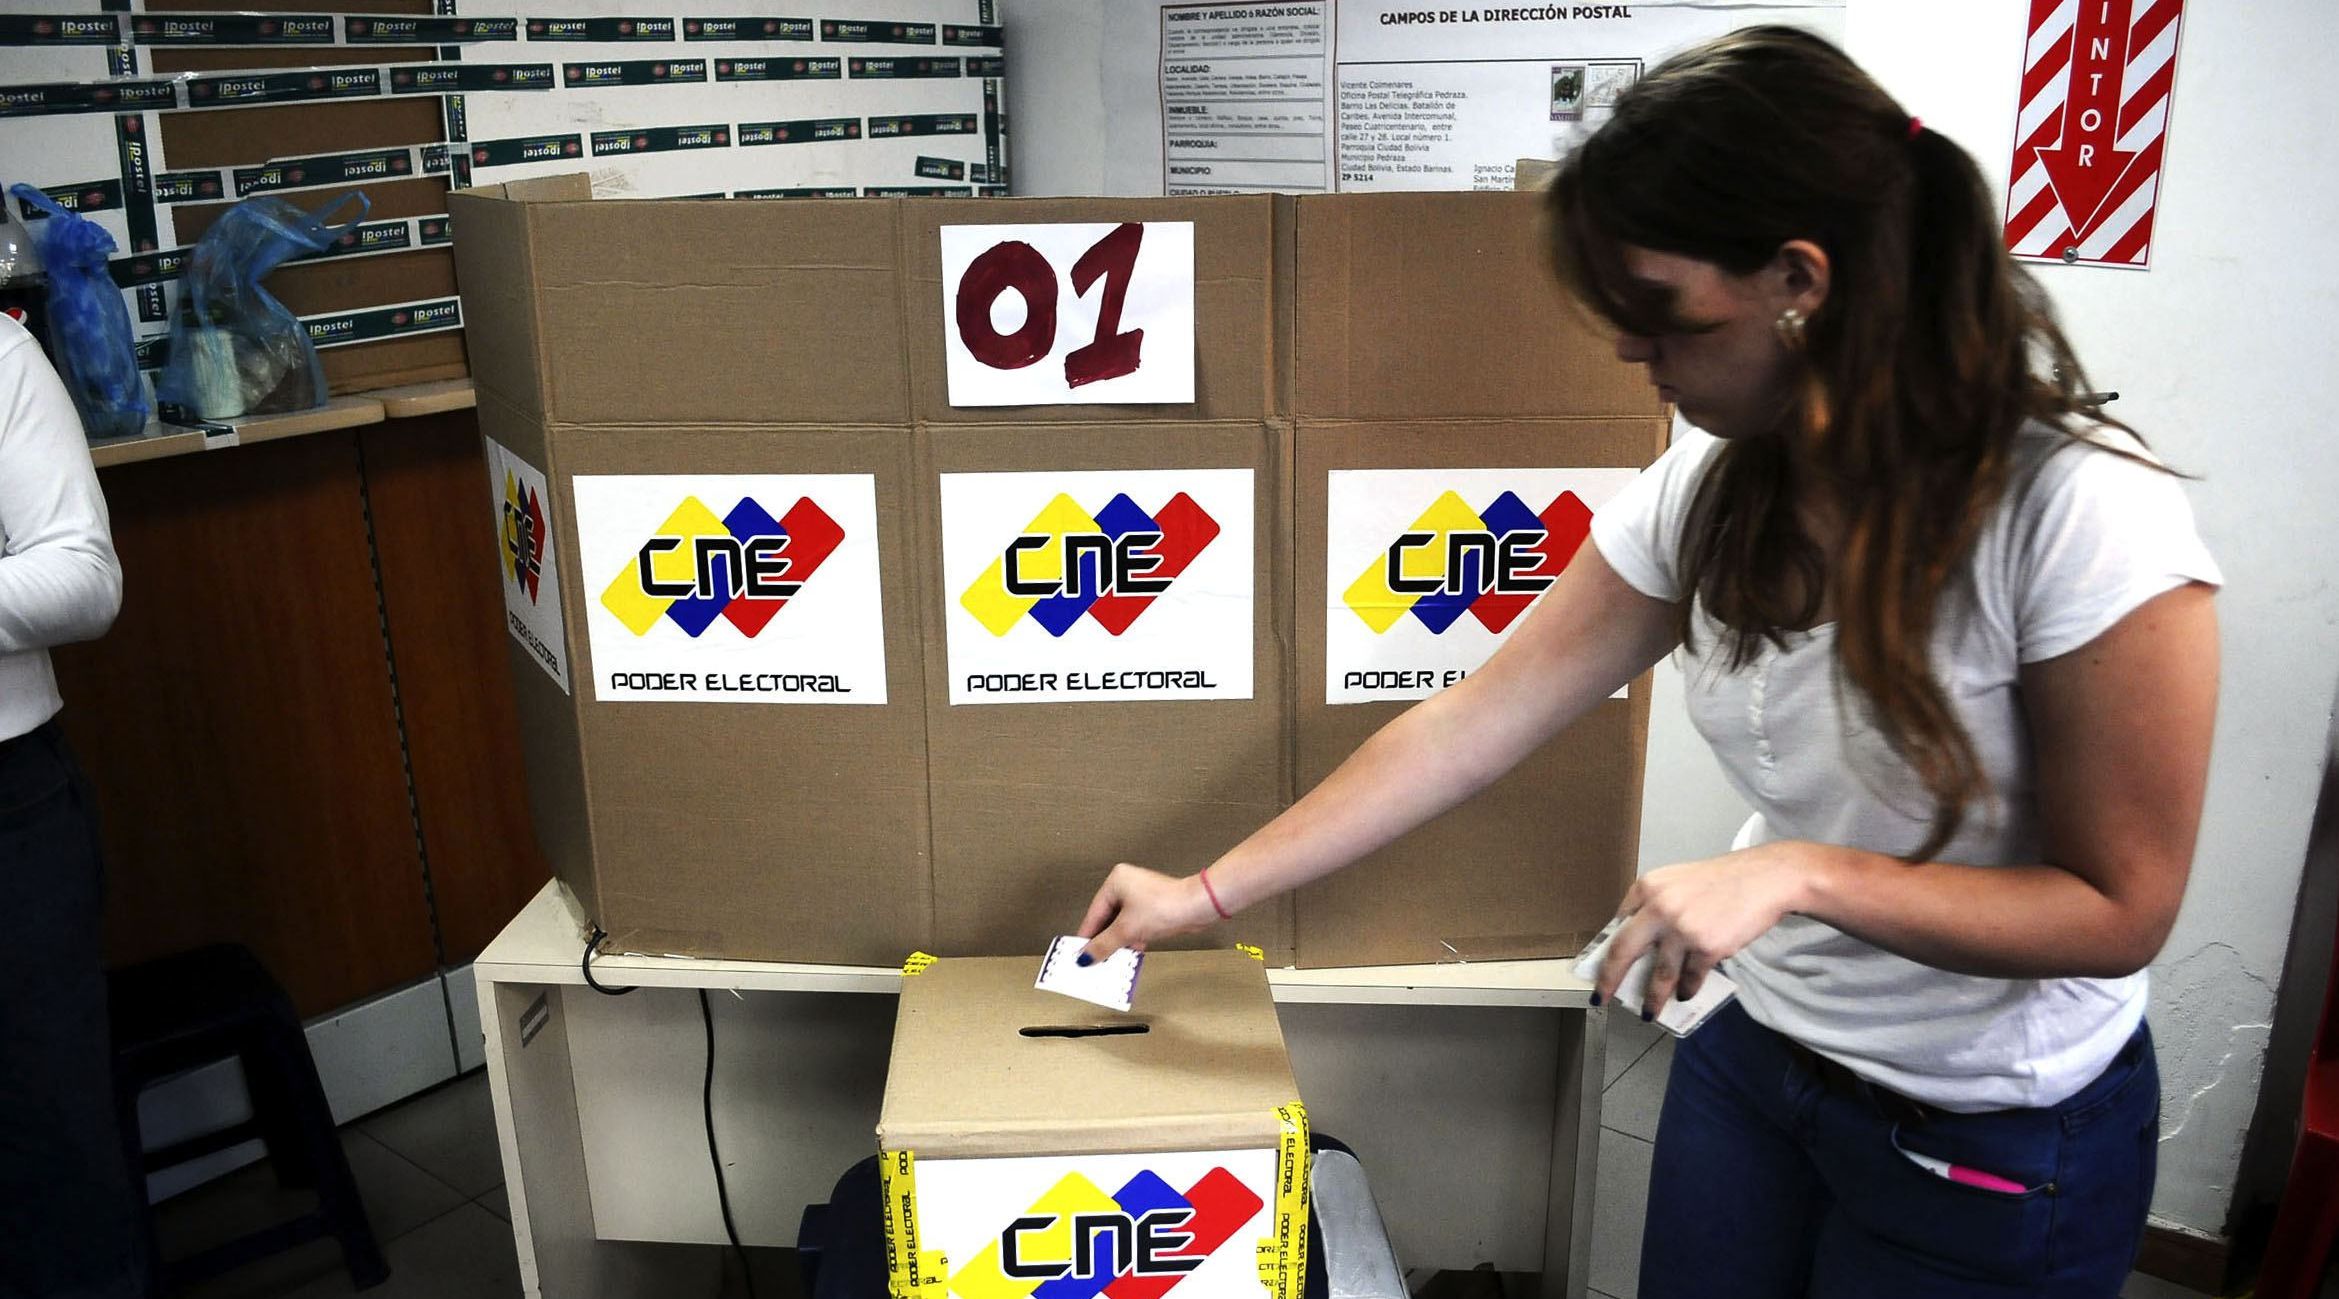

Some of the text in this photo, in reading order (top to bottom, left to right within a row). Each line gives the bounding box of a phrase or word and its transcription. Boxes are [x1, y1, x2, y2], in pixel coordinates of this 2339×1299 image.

[1168, 12, 1202, 22] NOMBRE
[1202, 12, 1209, 20] Y
[1209, 10, 1247, 20] APELLIDO
[1255, 6, 1285, 17] RAZÓN
[1380, 4, 1632, 25] CAMPOS DE LA DIRECCIÓN POSTAL
[1369, 81, 1413, 89] Colmenares
[1368, 91, 1389, 99] Postal
[1445, 101, 1456, 109] de
[1372, 112, 1402, 120] Avenida
[1341, 123, 1362, 131] Paseo
[1432, 123, 1452, 131] entre
[1340, 133, 1359, 141] calle
[1359, 133, 1369, 141] 27
[1391, 133, 1411, 141] Local
[1341, 143, 1430, 152] Parroquia Ciudad Bolivia
[1341, 154, 1406, 163] Municipio Pedraza
[1341, 164, 1366, 172] Ciudad
[1396, 164, 1422, 173] Estado
[1474, 164, 1503, 174] Ignacio
[1341, 174, 1374, 182] ZP 5214
[1473, 174, 1489, 183] San
[956, 222, 1144, 389] 01
[639, 538, 803, 598] CNE
[1005, 534, 1173, 595] CNE
[1388, 532, 1555, 593] CNE
[611, 672, 851, 693] PODER ELECTORAL
[967, 671, 1217, 693] PODER ELECTORAL
[1344, 671, 1434, 690] PODER
[1282, 1137, 1296, 1199] ELECTORAL
[902, 1190, 919, 1287] PODER ELECTORAL
[1280, 1212, 1290, 1249] PODER
[1002, 1212, 1205, 1277] CNE
